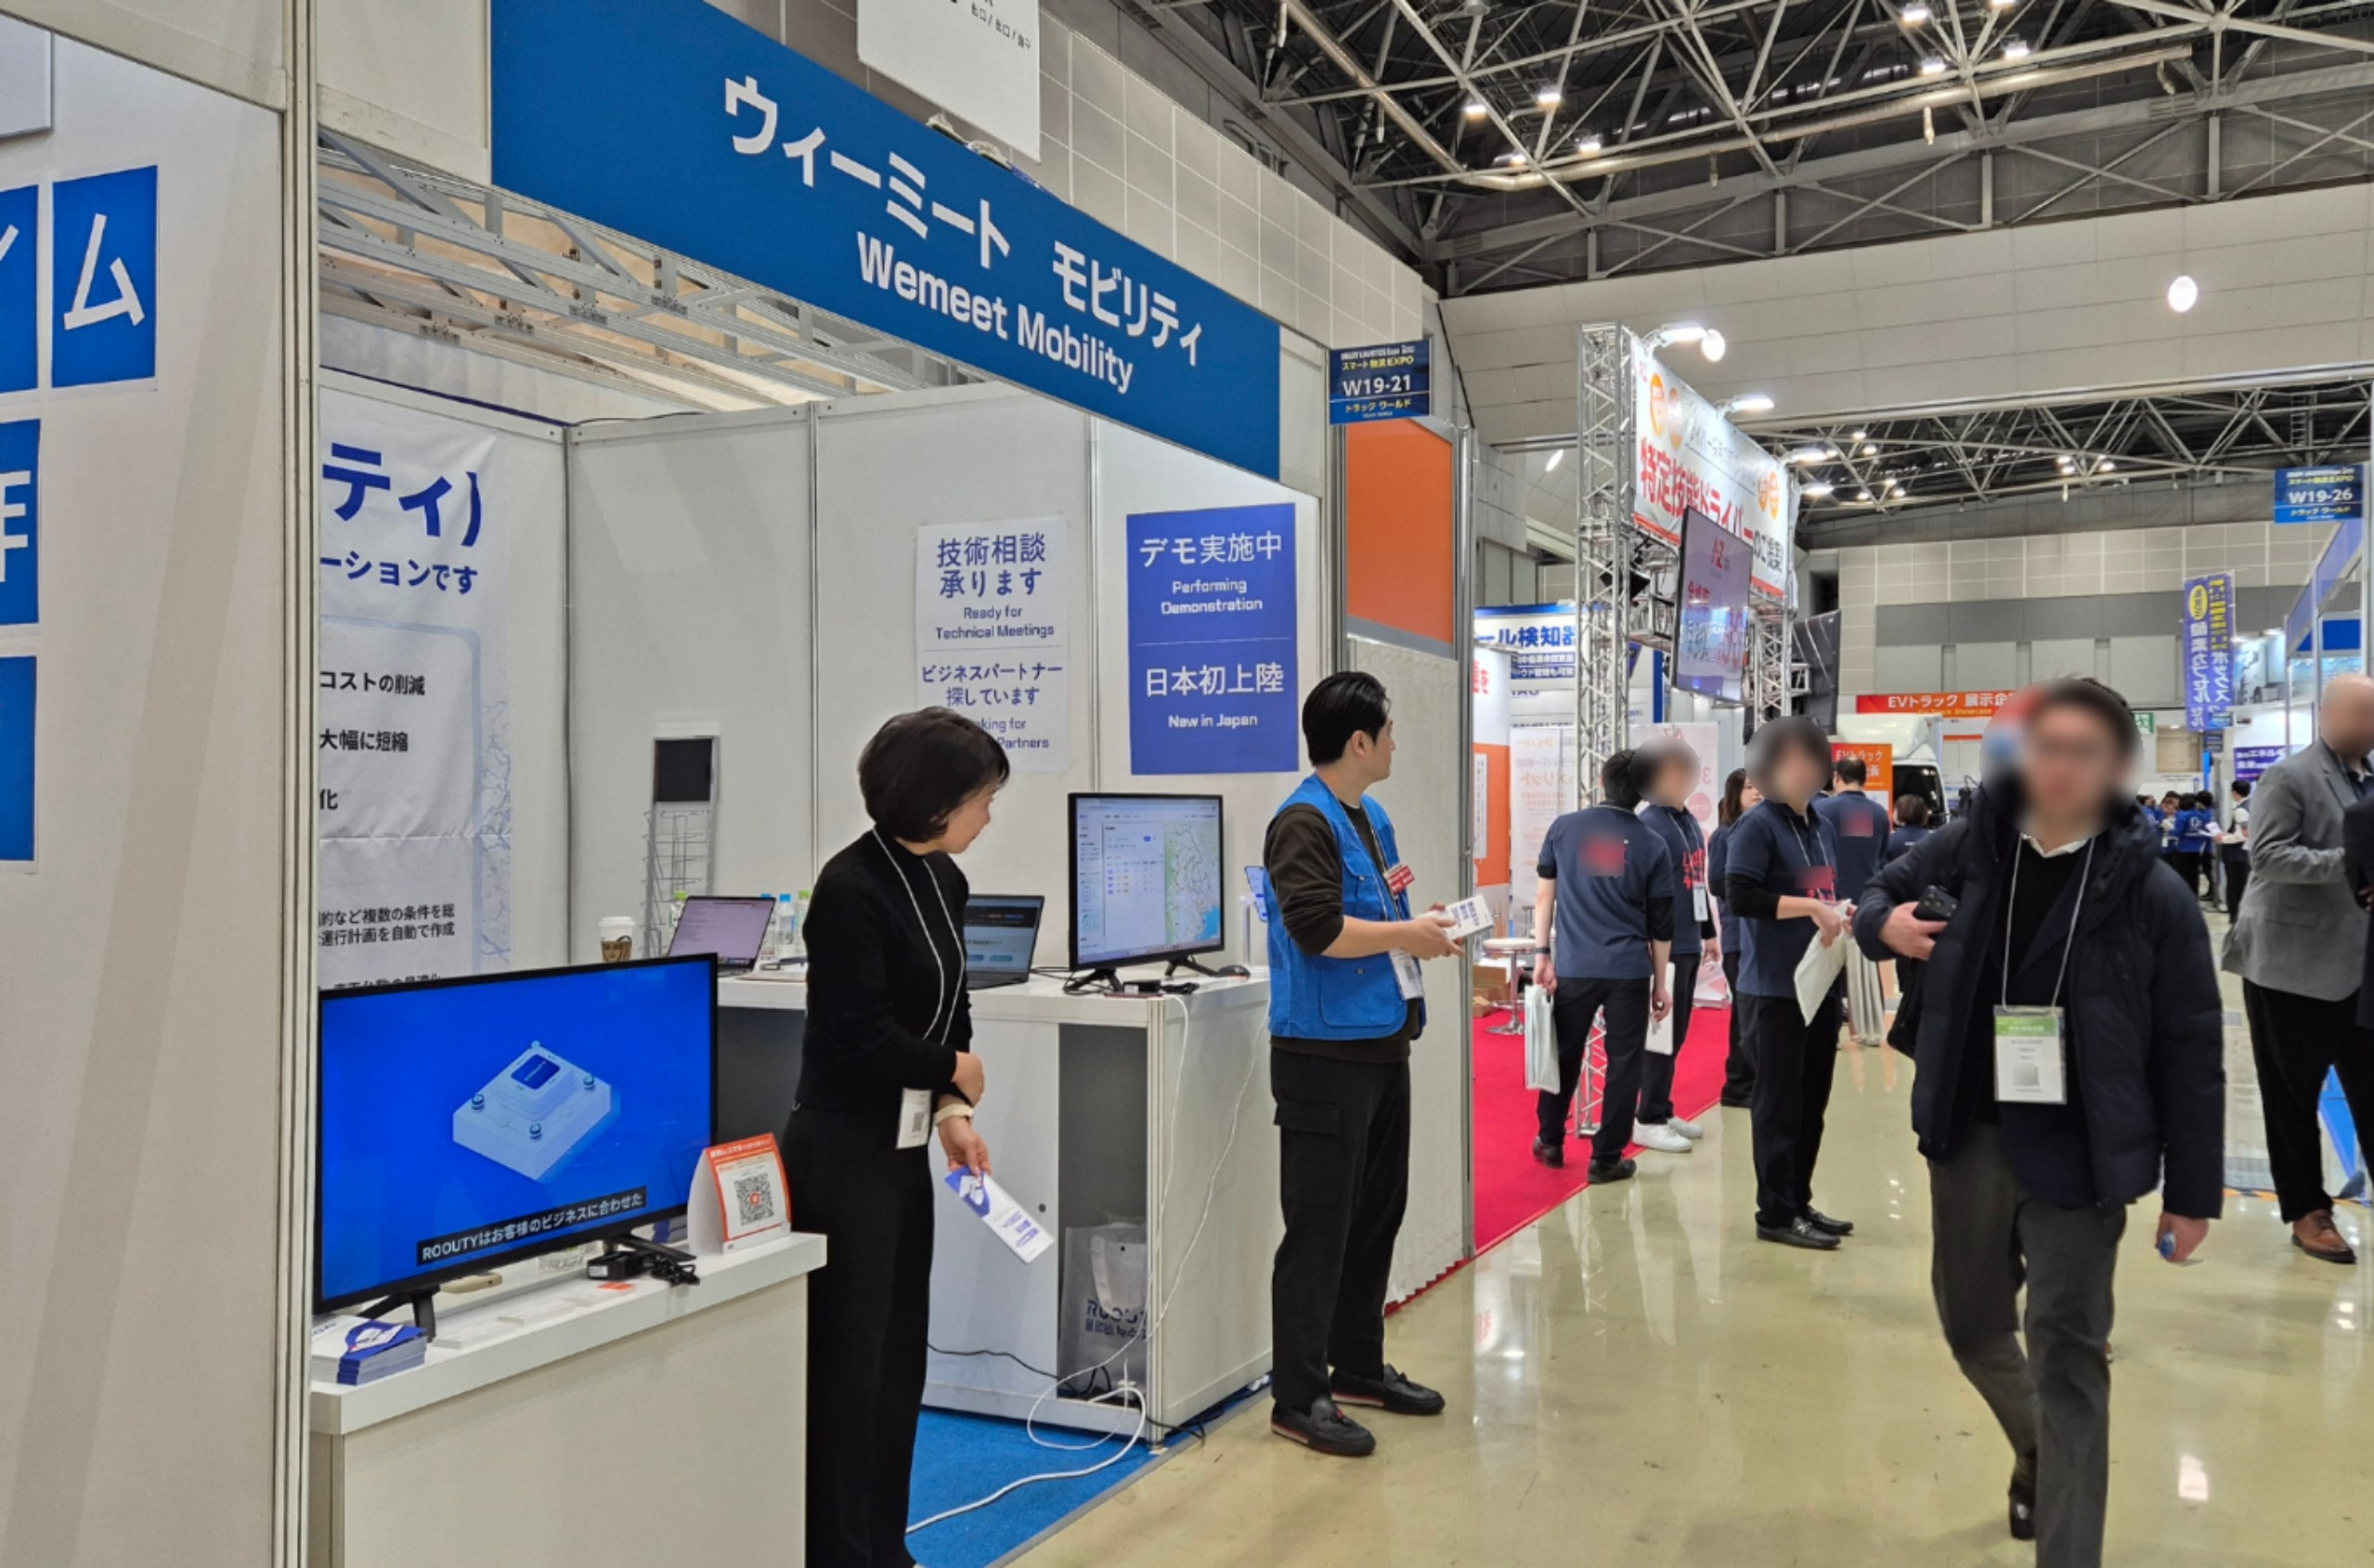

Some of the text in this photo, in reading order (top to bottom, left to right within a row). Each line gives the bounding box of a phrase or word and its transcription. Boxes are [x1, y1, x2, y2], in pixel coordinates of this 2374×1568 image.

[725, 75, 1202, 366] ウィーミート モビリティ
[857, 231, 1134, 395] Wemeet Mobility
[1343, 374, 1411, 396] W19-21
[322, 442, 481, 547] ティ)
[2289, 488, 2353, 504] W19-26
[937, 532, 1045, 568] 技術相談
[1140, 530, 1281, 567] デモ実施中
[319, 551, 478, 594] ーションです
[940, 568, 1042, 598] 承ります
[1173, 578, 1247, 594] Performing
[964, 605, 1022, 621] Ready for
[1161, 599, 1263, 616] Demonstration
[936, 624, 1055, 640] Technical Meetings
[319, 670, 425, 696] コストの削減
[922, 662, 1063, 682] ビジネスパートナー
[1147, 662, 1284, 696] 日本初上陸
[947, 686, 1040, 706] 探しています
[1888, 693, 2017, 708] EVトラック 展示企
[975, 718, 1027, 732] king for
[1168, 713, 1258, 729] New in Japan
[319, 729, 409, 753] 大幅に短縮
[997, 736, 1050, 749] Partners
[318, 903, 455, 927] 的など複数の条件を総
[318, 921, 455, 947] 運行計画を自動で作成
[422, 1191, 643, 1261] ROOUTYはお客様のビジネスに合わせた
